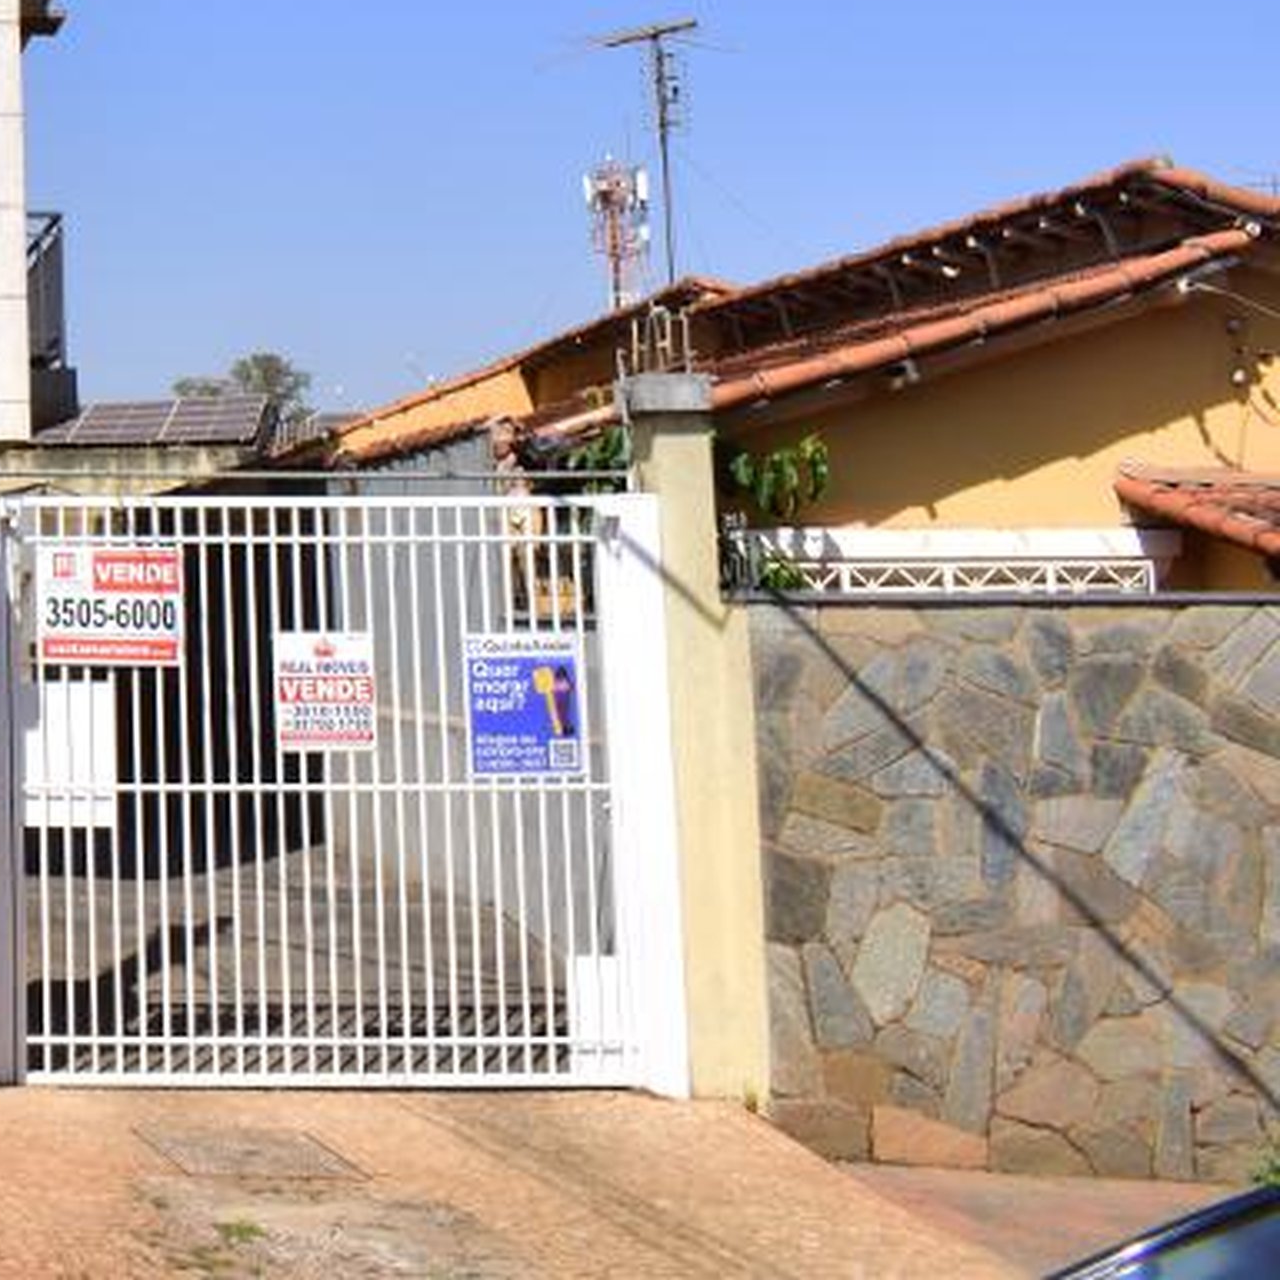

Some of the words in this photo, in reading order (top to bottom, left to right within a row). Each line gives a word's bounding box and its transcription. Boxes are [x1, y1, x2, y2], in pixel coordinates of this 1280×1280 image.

[95, 563, 176, 584] VENDE
[46, 596, 175, 630] 3505-6000
[473, 662, 519, 677] Quer
[280, 679, 373, 701] VENDE
